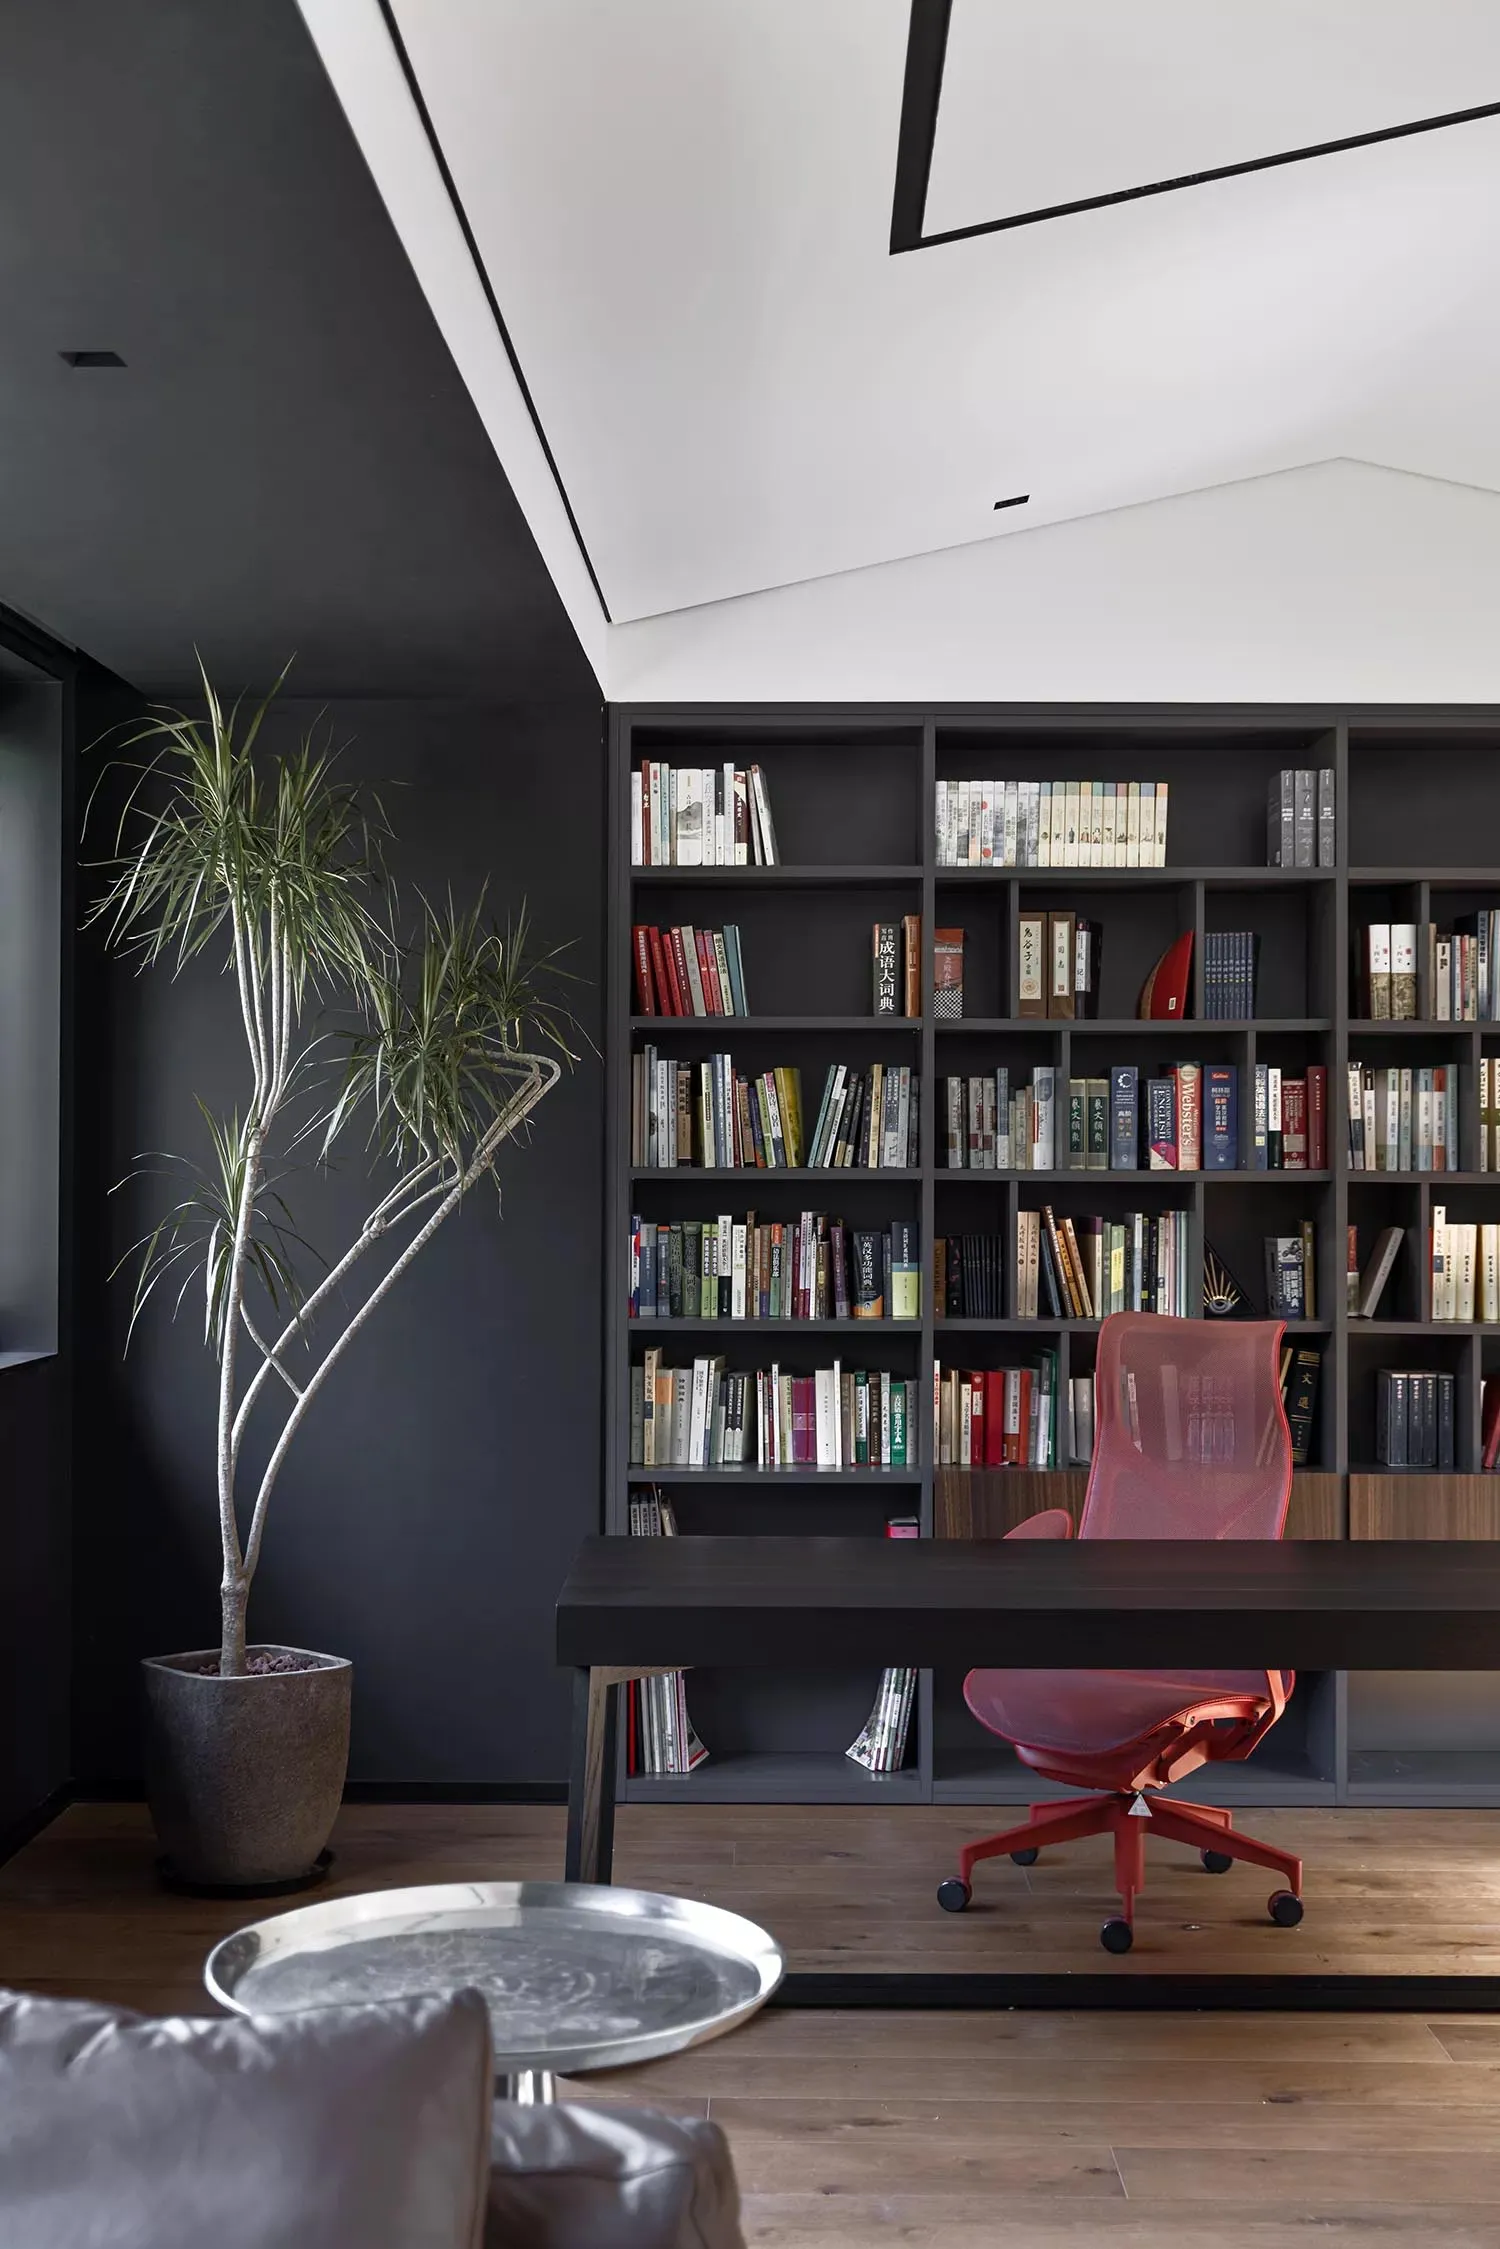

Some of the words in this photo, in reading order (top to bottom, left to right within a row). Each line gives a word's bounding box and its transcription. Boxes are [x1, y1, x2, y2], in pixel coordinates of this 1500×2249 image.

[879, 941, 895, 1011] 成语大词典
[1182, 1082, 1196, 1146] Webster's
[862, 1241, 873, 1286] 英汉多功能词典
